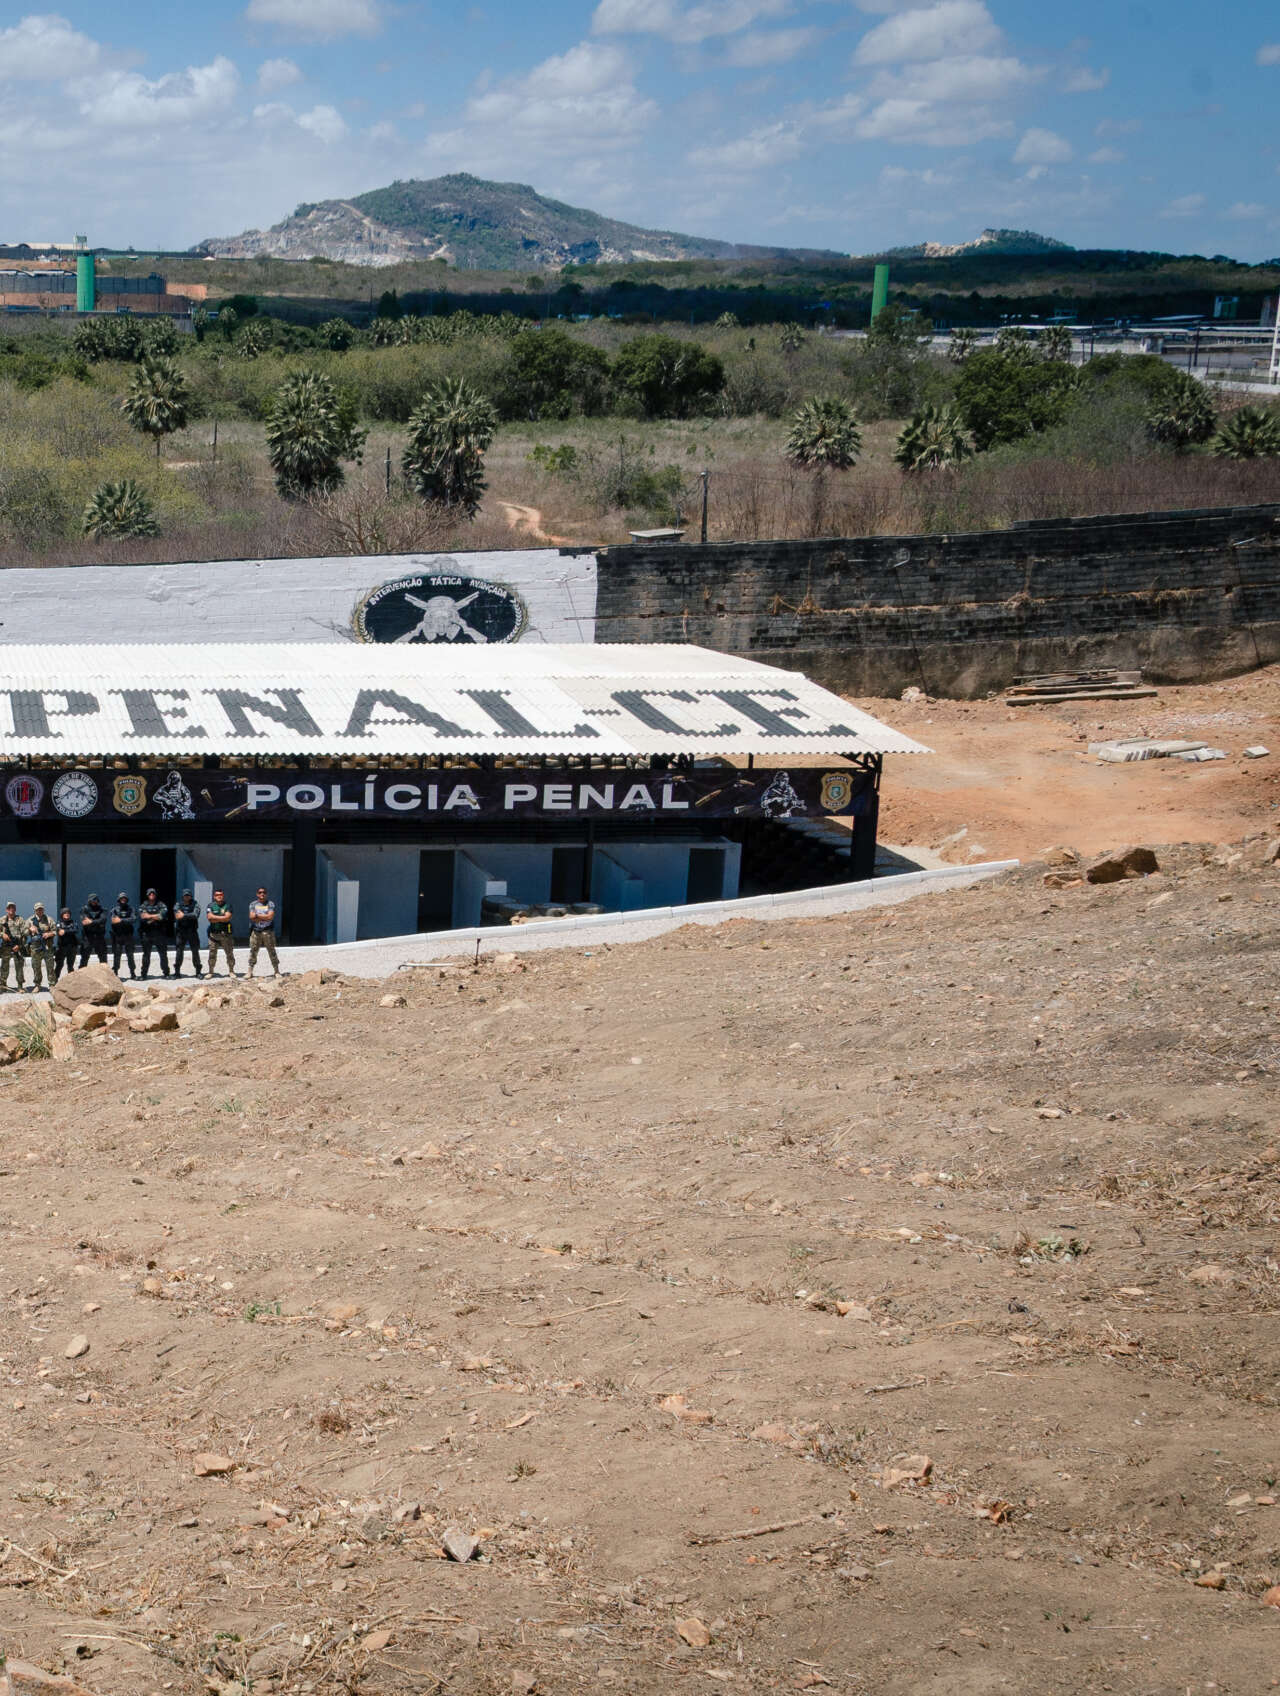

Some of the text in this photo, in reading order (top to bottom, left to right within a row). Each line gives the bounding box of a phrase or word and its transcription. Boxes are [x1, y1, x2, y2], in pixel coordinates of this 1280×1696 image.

[369, 576, 508, 606] INTERVENÇÃO TÁTICA AVANÇADA
[247, 774, 689, 811] POLÍCIA PENAL
